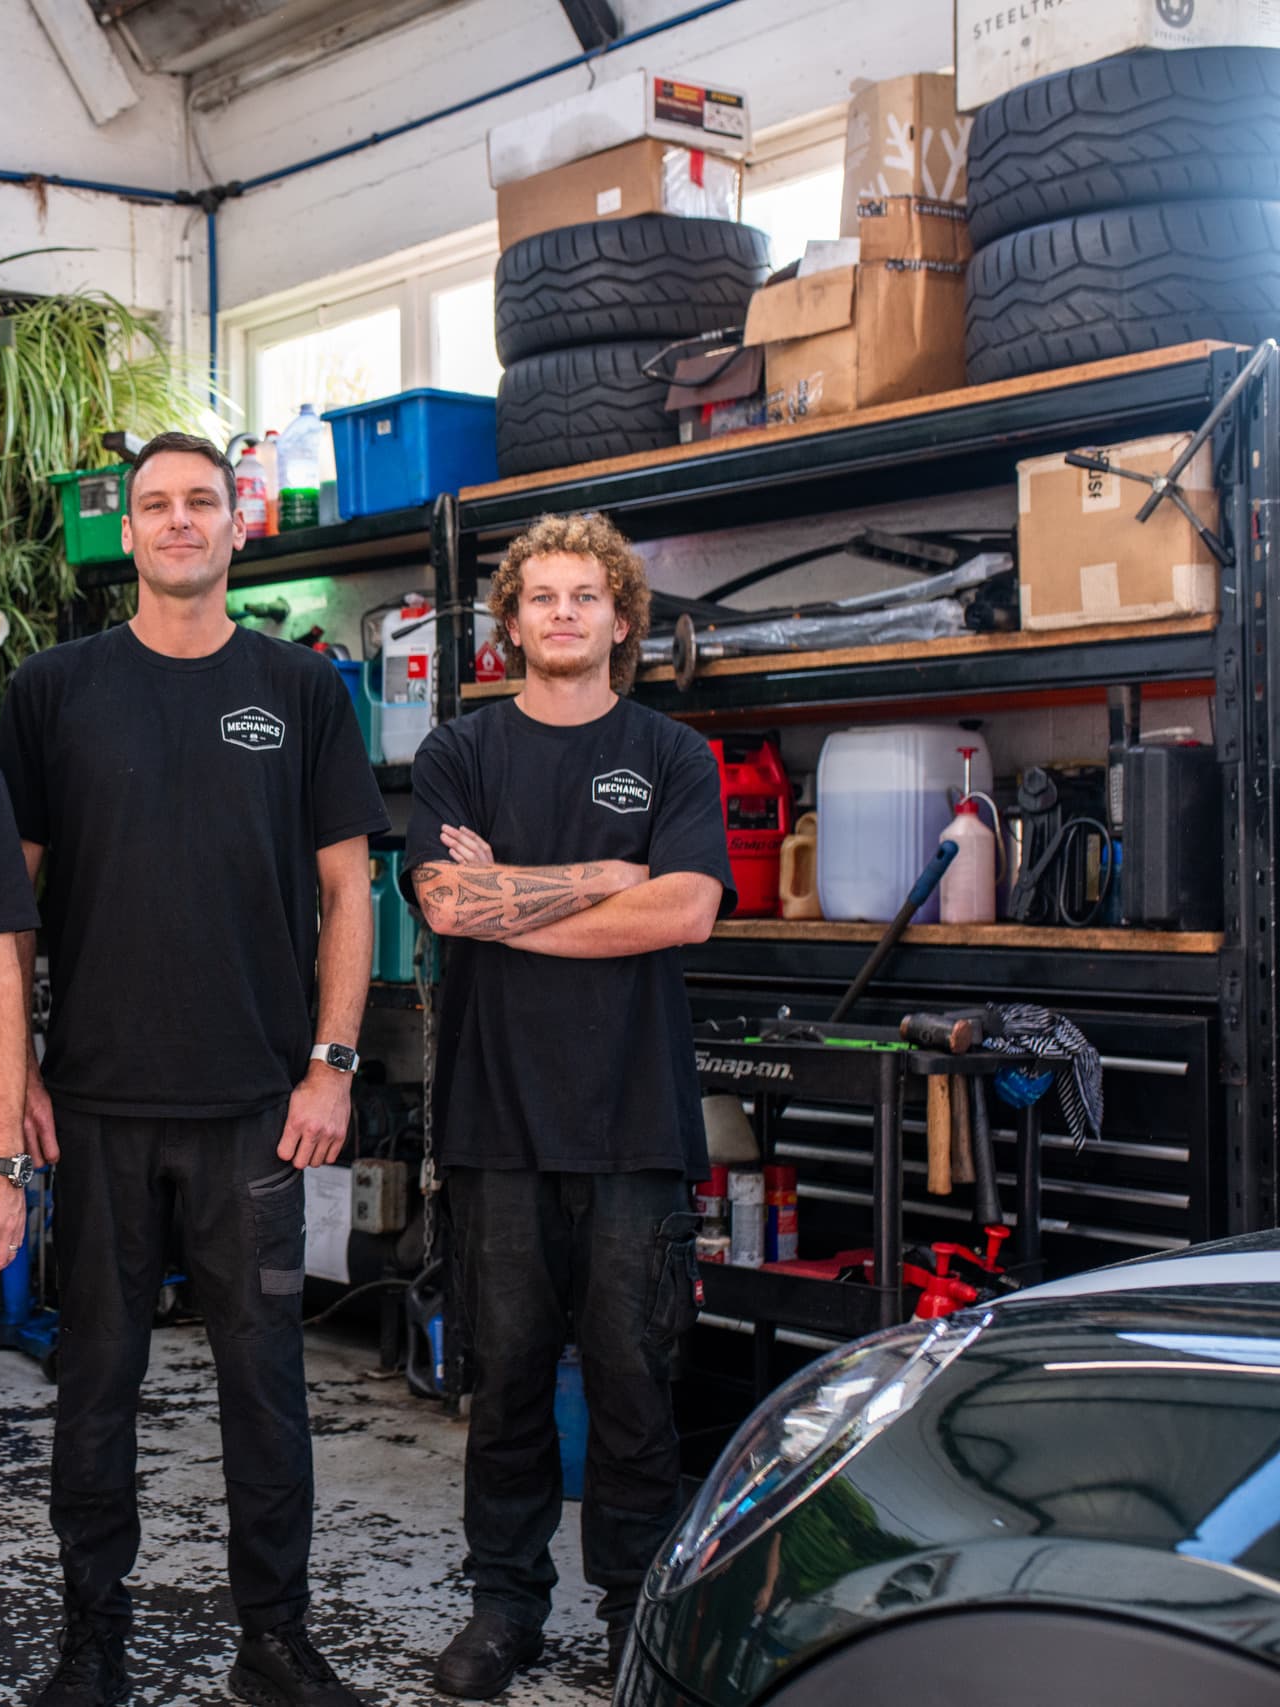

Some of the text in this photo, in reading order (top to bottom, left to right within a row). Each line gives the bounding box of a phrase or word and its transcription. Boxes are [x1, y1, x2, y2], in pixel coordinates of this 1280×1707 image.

[973, 0, 1062, 40] STEELTR
[227, 721, 280, 737] MECHANICS
[598, 783, 648, 801] MECHANICS
